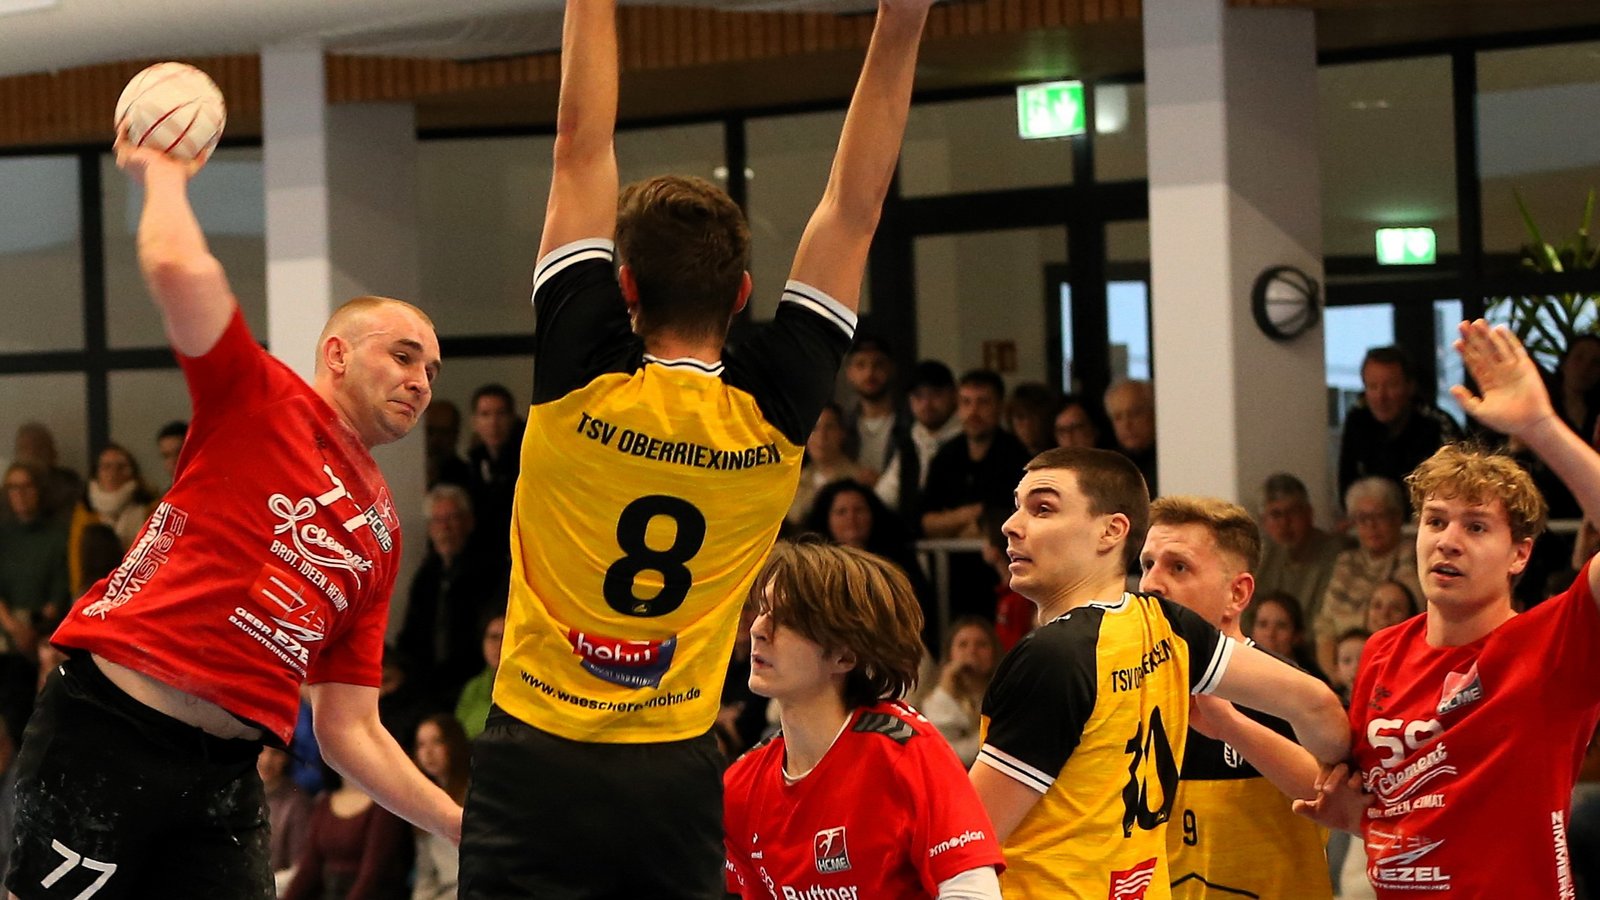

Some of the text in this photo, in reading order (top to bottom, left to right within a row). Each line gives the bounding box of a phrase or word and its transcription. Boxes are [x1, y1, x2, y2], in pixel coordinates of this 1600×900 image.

[577, 412, 781, 470] TSV OBERRIEXINGEN
[301, 524, 373, 572] Clement
[365, 509, 392, 551] HCME
[270, 540, 301, 568] BROT.
[298, 560, 326, 591] IDEEN.
[603, 494, 706, 617] 8
[235, 607, 310, 666] GEBR. EZE
[1112, 668, 1133, 693] TSV
[1122, 705, 1180, 838] 10
[1183, 809, 1198, 846] 9
[41, 838, 117, 900] 77
[818, 856, 848, 872] HCME
[1379, 866, 1451, 882] EZEL
